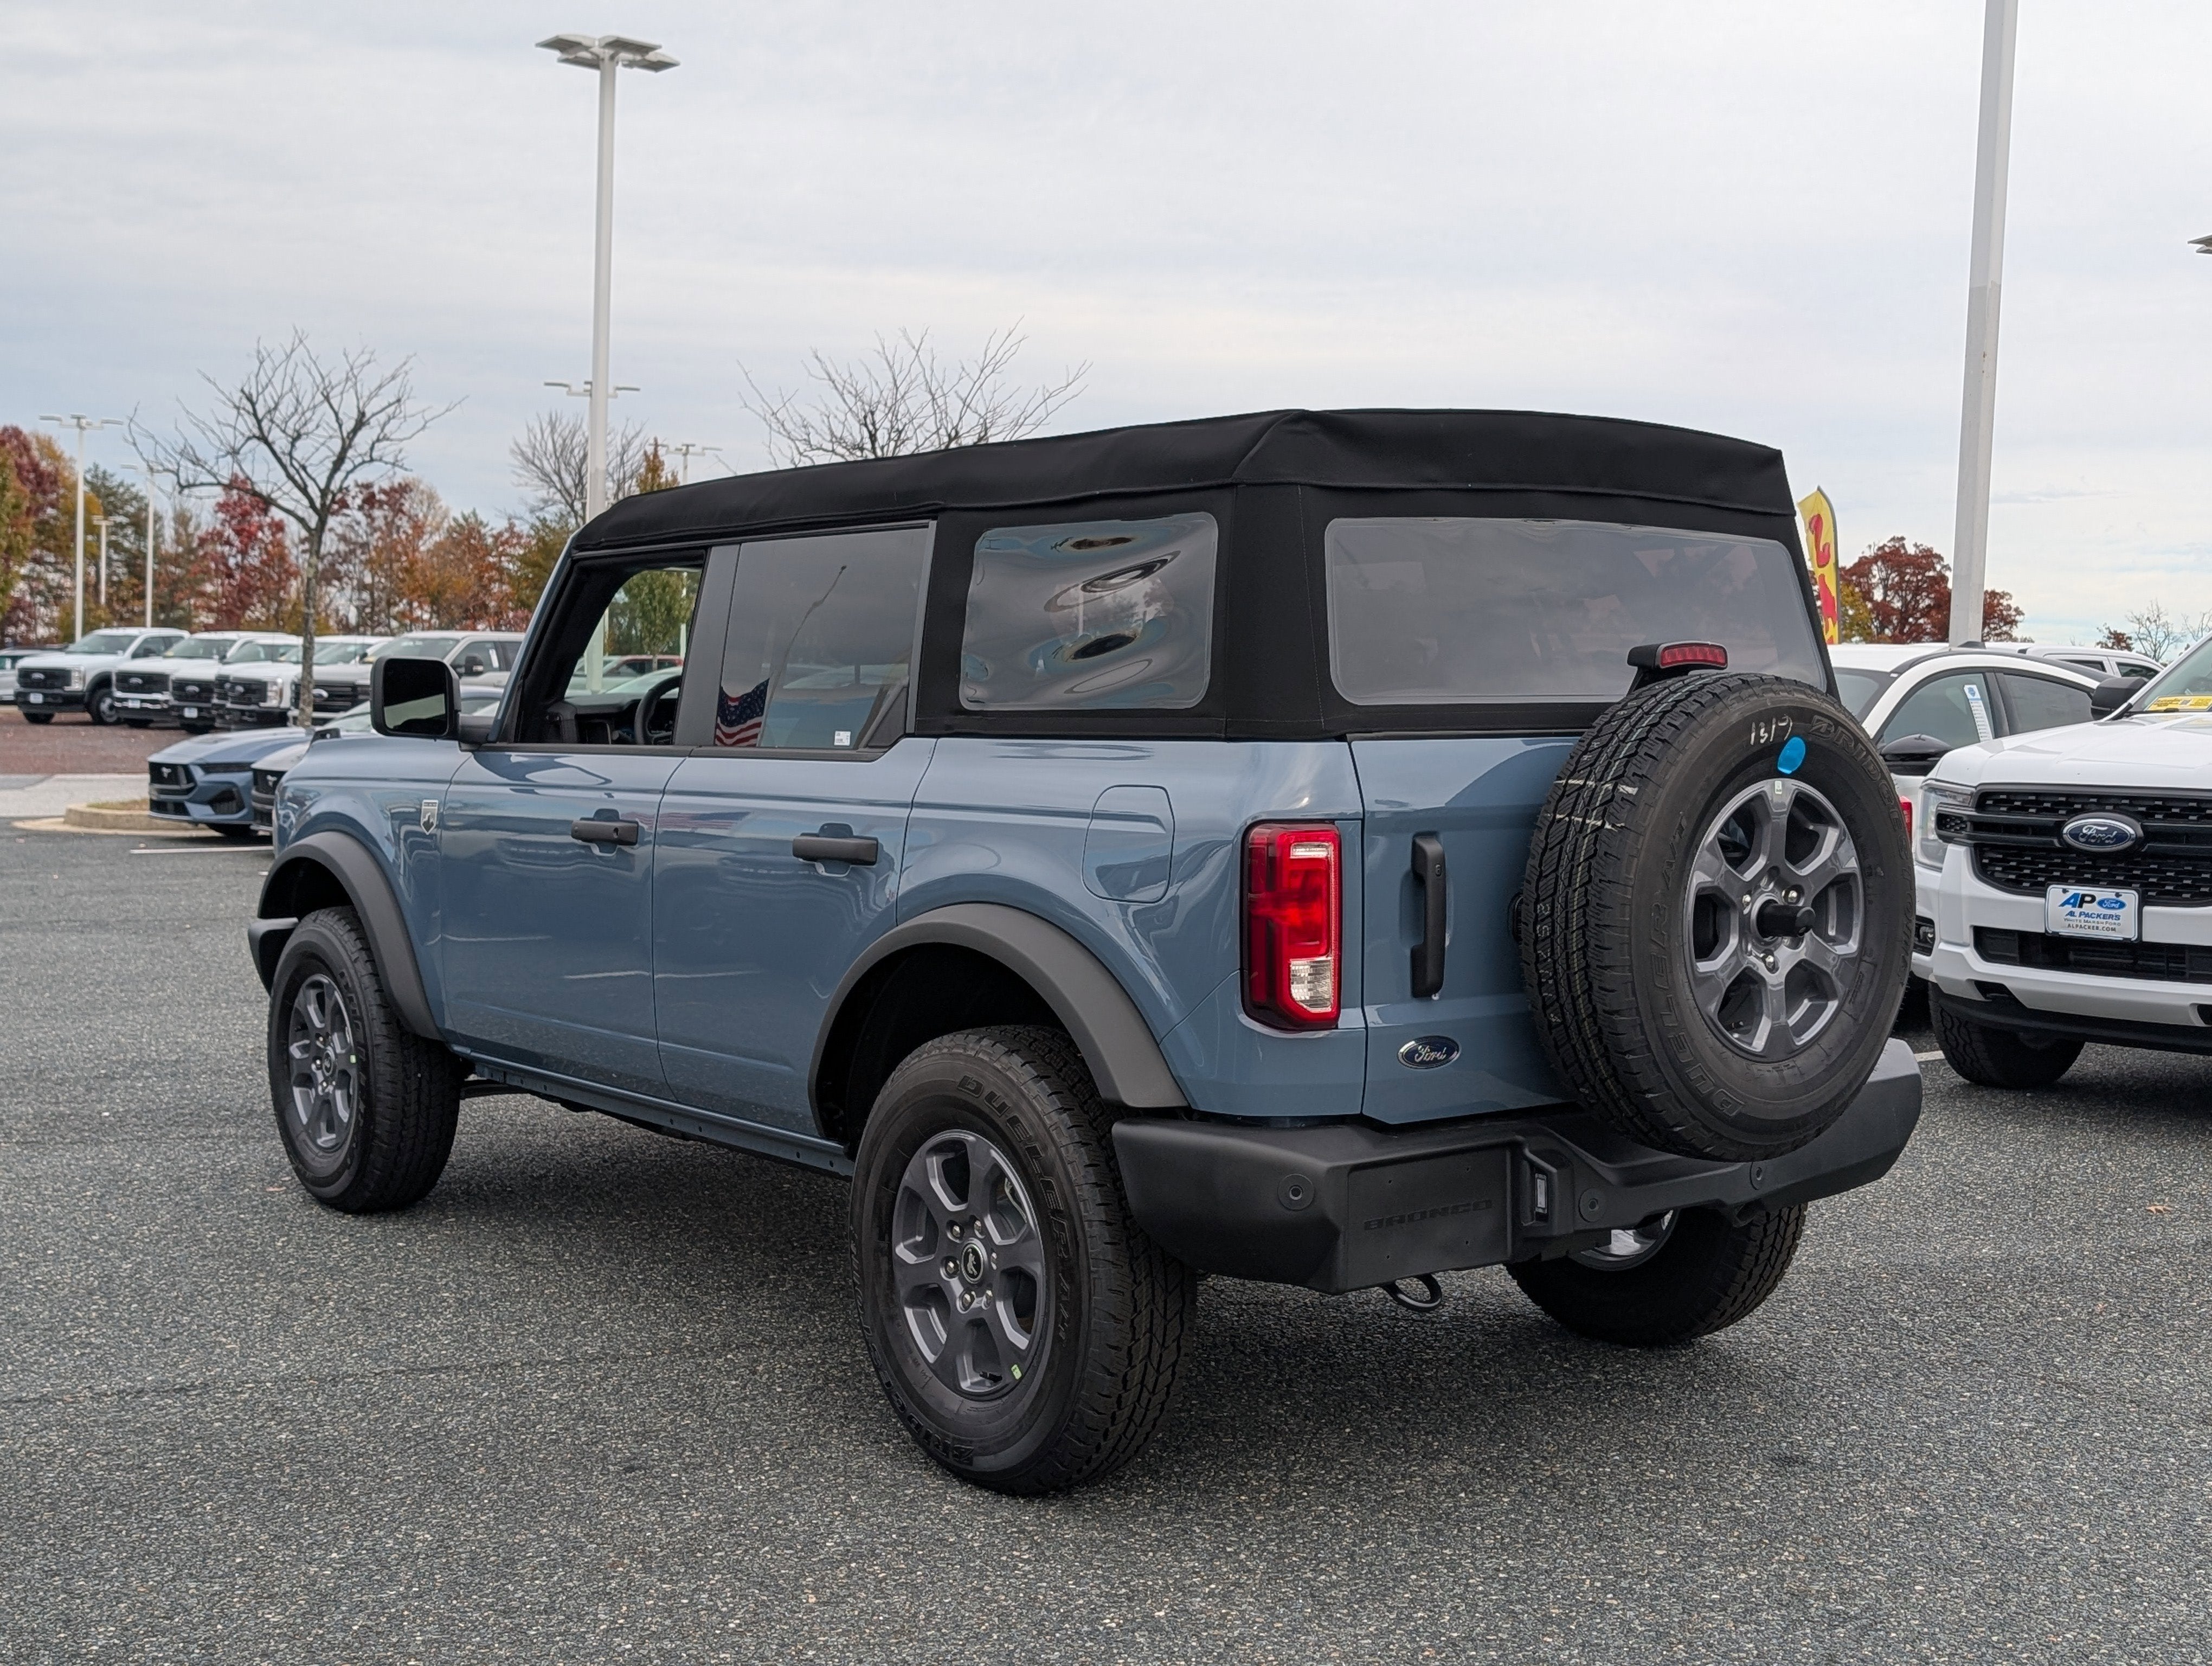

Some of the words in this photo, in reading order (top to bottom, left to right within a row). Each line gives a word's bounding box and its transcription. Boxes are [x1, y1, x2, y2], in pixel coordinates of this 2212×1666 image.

[2079, 825, 2118, 843] Ford
[2059, 893, 2097, 908] AP
[2079, 911, 2121, 921] PACKER'S
[1414, 1045, 1447, 1062] Ford
[1364, 1199, 1491, 1231] BRONCO
